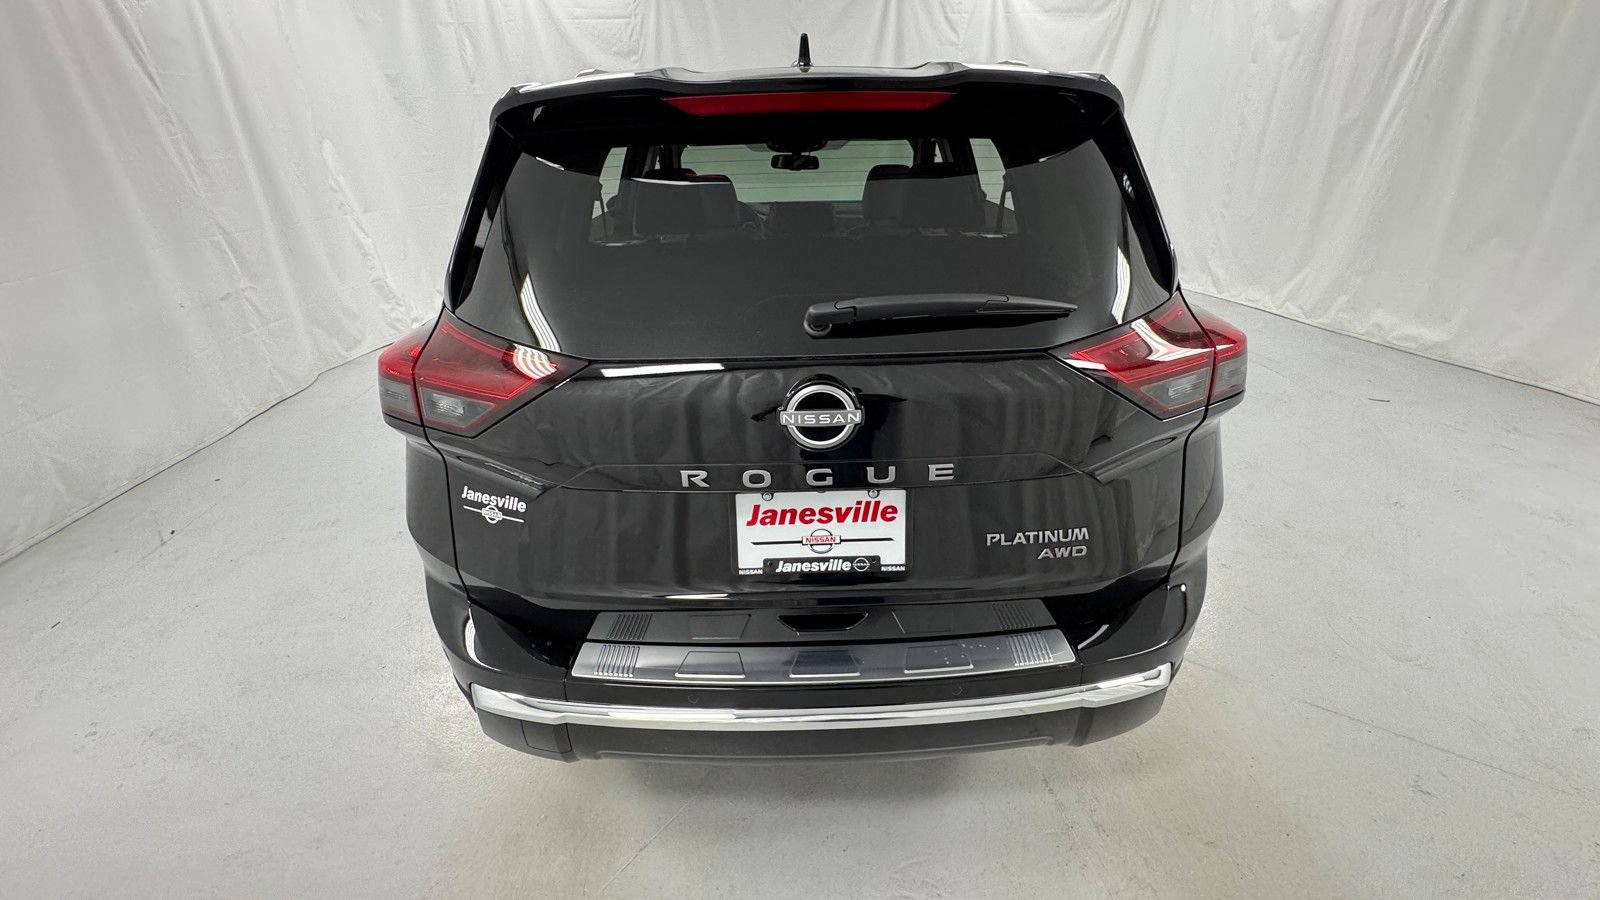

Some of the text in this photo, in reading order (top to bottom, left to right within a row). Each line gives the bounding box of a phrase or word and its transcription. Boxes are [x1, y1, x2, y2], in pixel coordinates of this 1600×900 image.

[782, 412, 860, 425] NISSAN
[461, 486, 527, 512] Janesville
[746, 500, 898, 526] Janesville
[805, 536, 837, 544] NISSAN
[986, 527, 1089, 546] PLATINUM
[1037, 545, 1088, 560] AWD
[775, 559, 851, 573] Janesville
